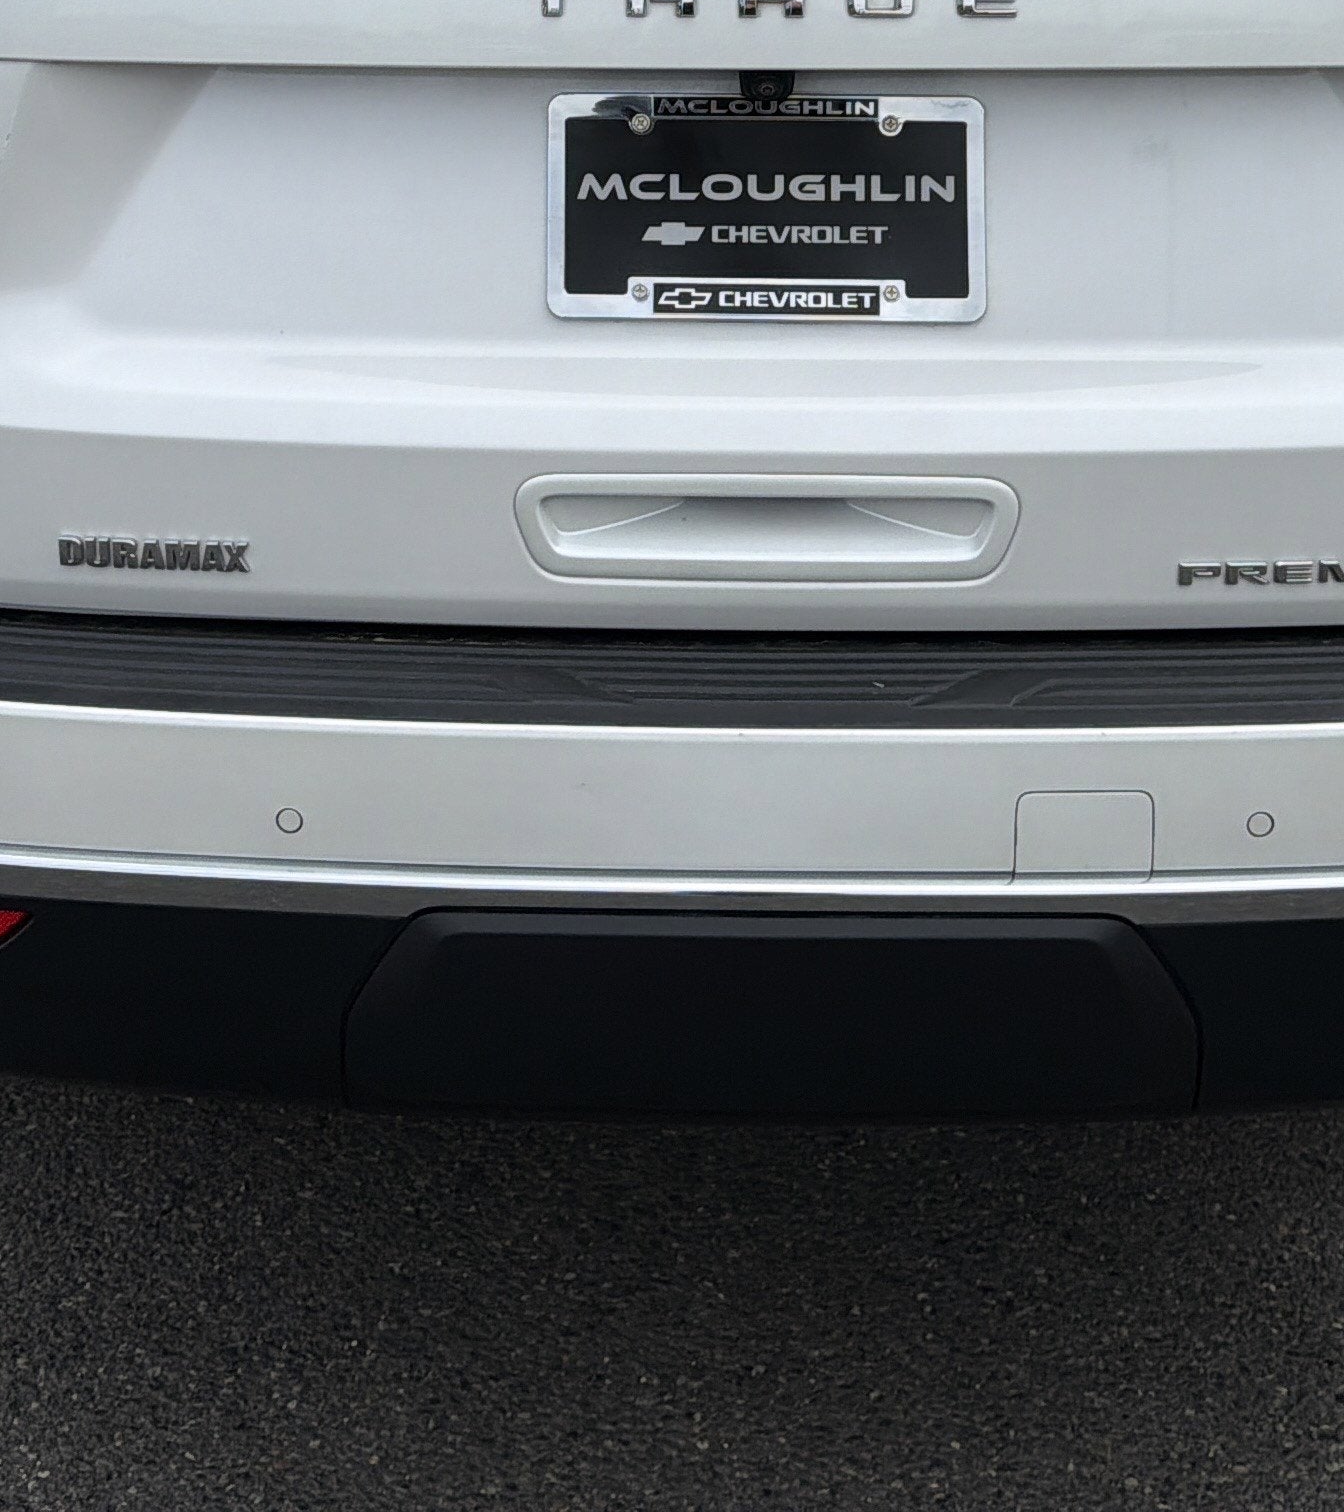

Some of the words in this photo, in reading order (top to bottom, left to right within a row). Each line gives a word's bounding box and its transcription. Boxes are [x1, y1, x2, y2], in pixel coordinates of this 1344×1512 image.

[657, 99, 876, 116] MCLOUGHLIN
[577, 173, 955, 202] MCLOUGHLIN
[711, 225, 889, 244] CHEVROLET
[718, 290, 877, 309] CHEVROLET
[58, 534, 251, 573] DURAMAX
